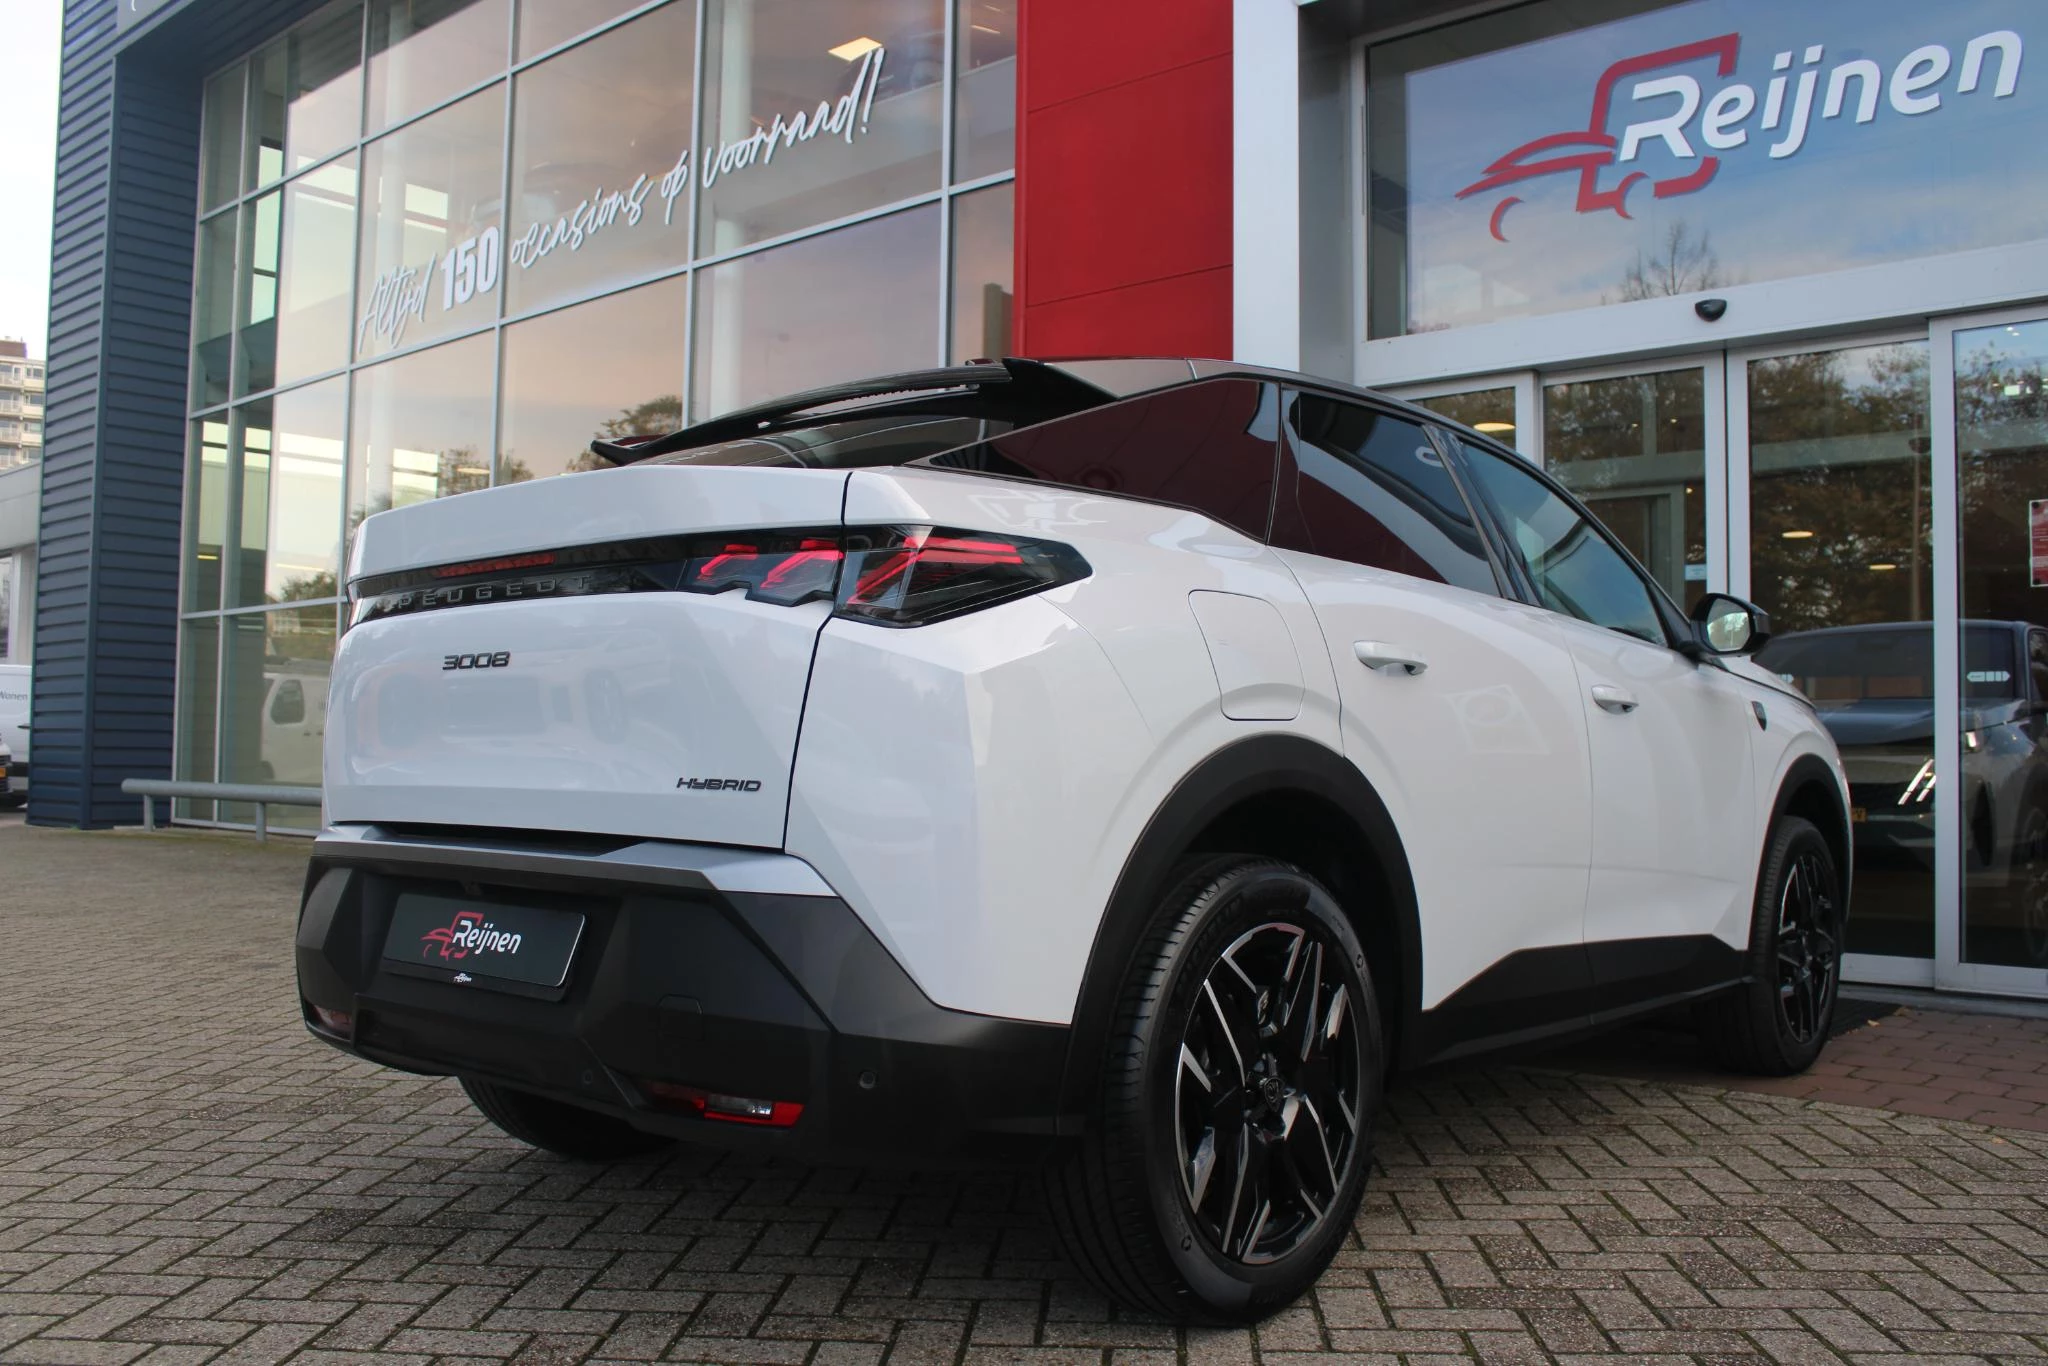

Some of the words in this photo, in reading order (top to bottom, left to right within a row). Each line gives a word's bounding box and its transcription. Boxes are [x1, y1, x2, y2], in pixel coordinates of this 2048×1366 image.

[1619, 30, 2023, 162] Reijnen
[357, 251, 437, 354] Altijd
[441, 226, 500, 312] 150
[511, 172, 654, 269] occasions
[661, 149, 688, 224] op
[398, 575, 592, 607] PEUGEOT
[442, 650, 511, 671] 3008
[677, 776, 762, 793] HYBRID
[452, 919, 522, 955] Reijnen
